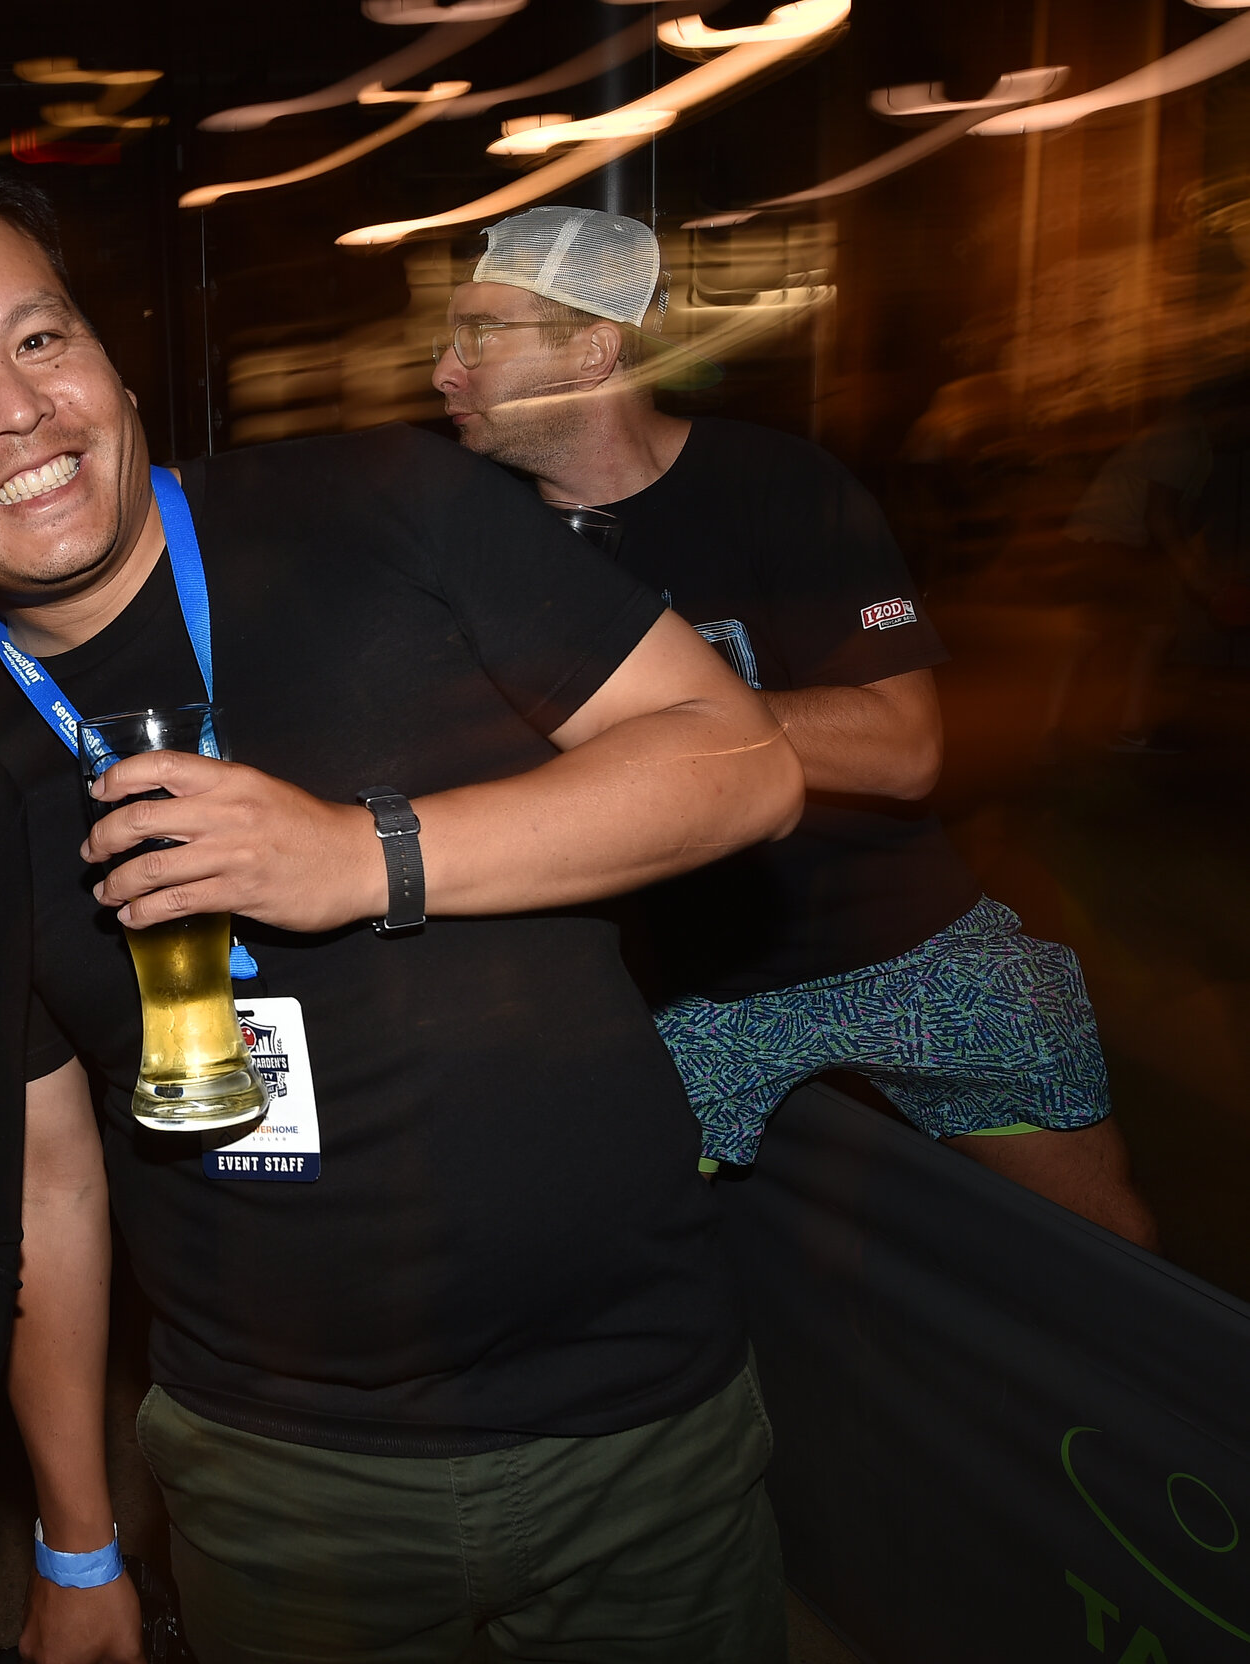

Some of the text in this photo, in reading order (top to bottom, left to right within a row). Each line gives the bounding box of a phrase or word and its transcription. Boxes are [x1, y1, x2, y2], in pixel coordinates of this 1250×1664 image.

[865, 602, 902, 624] IZOD
[218, 1155, 305, 1173] EVENT STAFF
